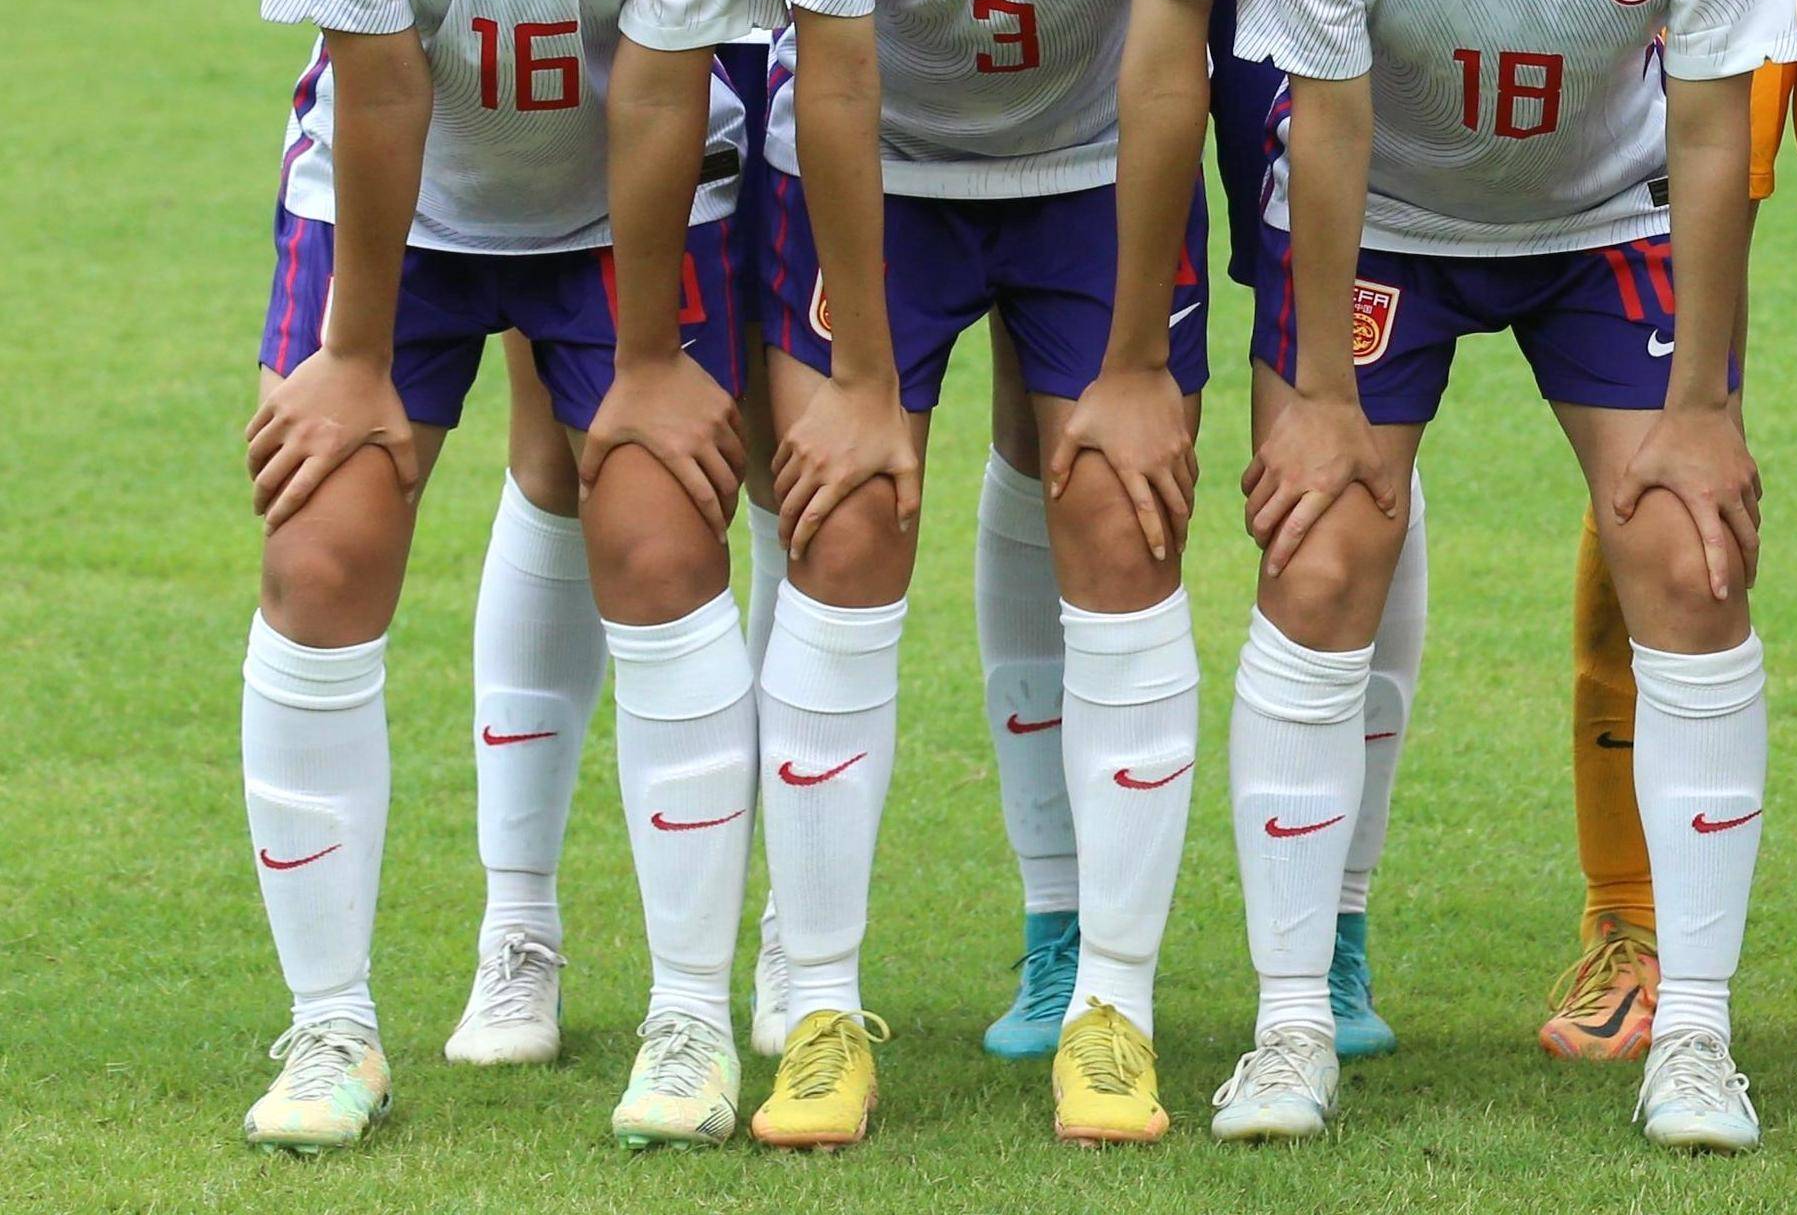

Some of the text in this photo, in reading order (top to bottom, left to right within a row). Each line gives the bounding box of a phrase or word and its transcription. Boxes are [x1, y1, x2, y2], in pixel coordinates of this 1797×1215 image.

[471, 16, 580, 112] 16
[1453, 49, 1563, 140] 18
[1354, 287, 1390, 310] FA
